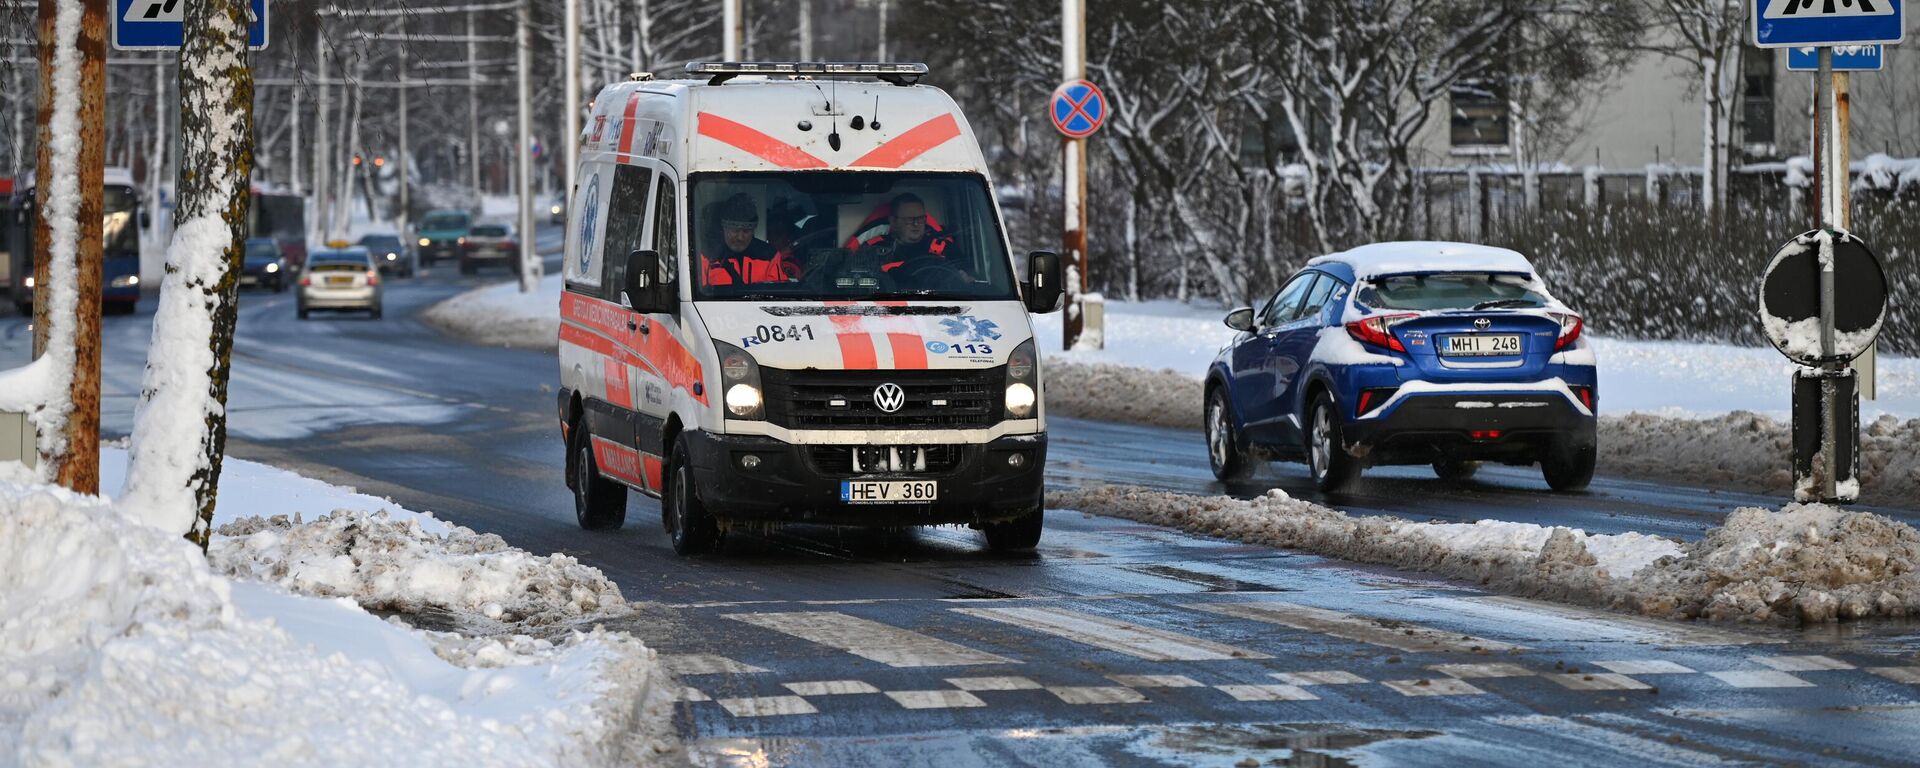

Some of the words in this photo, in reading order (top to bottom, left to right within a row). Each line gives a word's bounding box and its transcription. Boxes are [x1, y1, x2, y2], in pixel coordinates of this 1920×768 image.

[950, 343, 993, 354] 113
[1452, 338, 1480, 351] MHI
[1492, 337, 1518, 350] 248
[852, 483, 890, 499] HEV
[902, 483, 934, 498] 360
